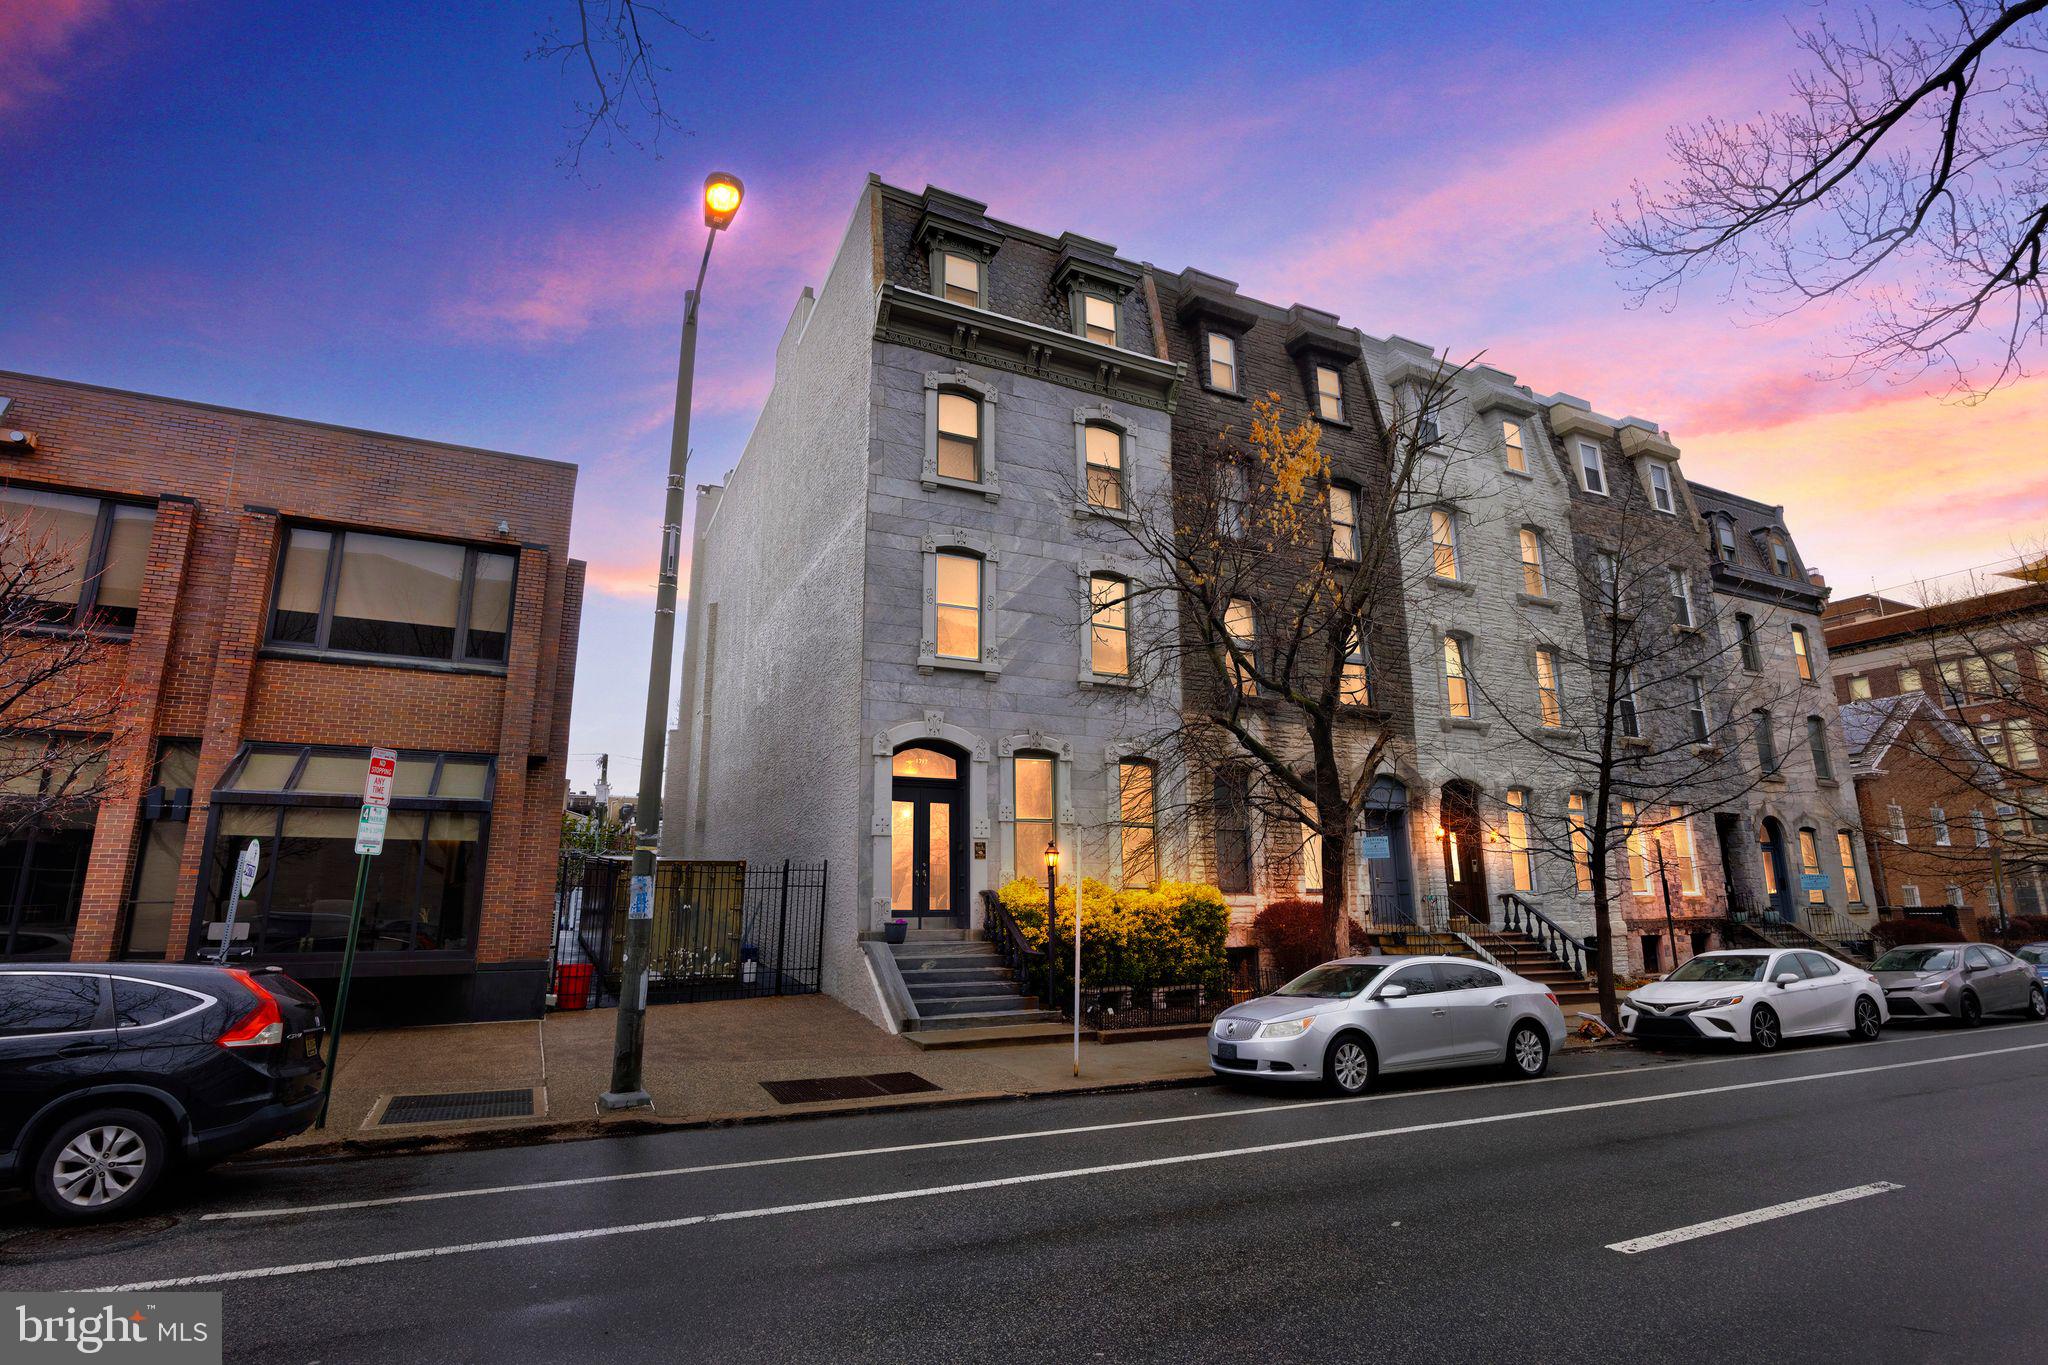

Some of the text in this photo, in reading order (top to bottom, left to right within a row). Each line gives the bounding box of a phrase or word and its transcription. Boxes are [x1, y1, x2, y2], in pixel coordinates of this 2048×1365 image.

[371, 767, 392, 775] STOPPING
[374, 777, 385, 786] ANY
[372, 785, 385, 795] TIME
[363, 808, 369, 820] 4
